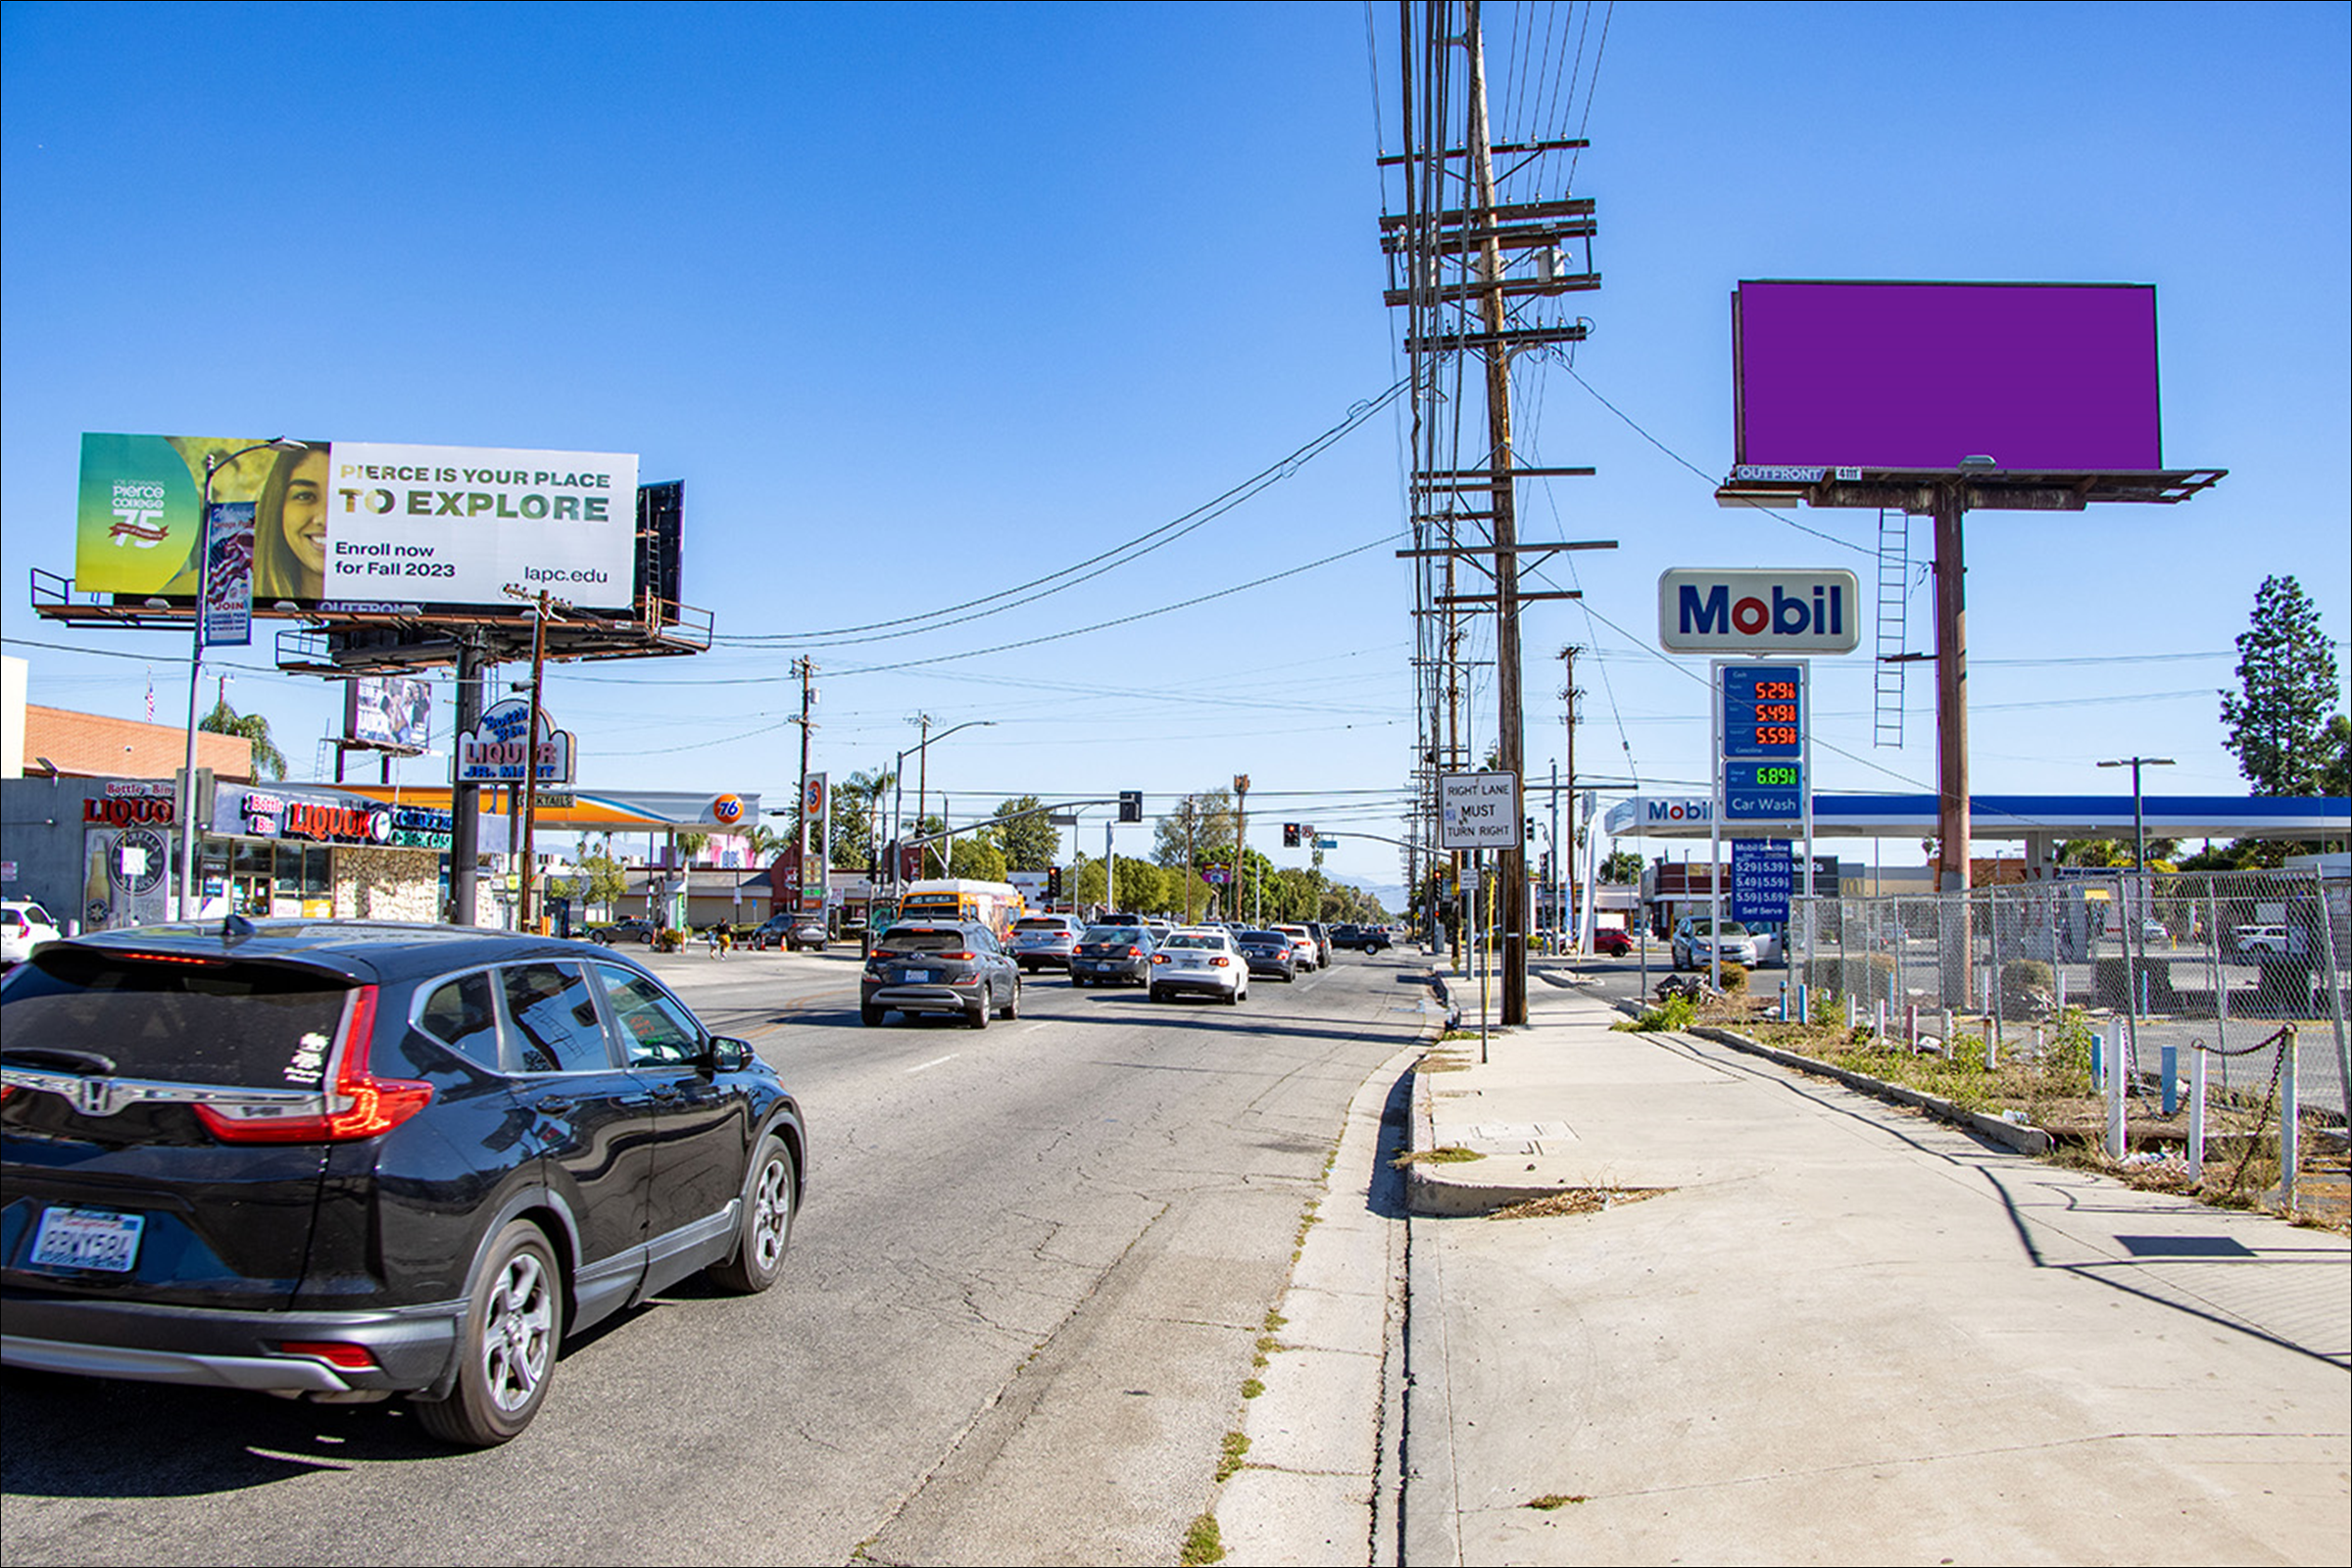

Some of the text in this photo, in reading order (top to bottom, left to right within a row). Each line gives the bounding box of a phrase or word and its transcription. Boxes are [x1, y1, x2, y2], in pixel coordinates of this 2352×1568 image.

[340, 465, 611, 488] PIERCE IS YOUR PLACE
[1740, 467, 1820, 480] OUTFRONT
[338, 488, 610, 522] TO EXPLORE
[112, 509, 165, 549] 75
[335, 541, 435, 558] Enroll now
[335, 560, 456, 578] for Fall 2023
[524, 565, 609, 585] lapc.edu
[215, 601, 244, 612] JOIN
[319, 601, 408, 613] OUTFRON
[1679, 585, 1842, 635] Mobil
[466, 743, 557, 765] LIQUR
[1447, 785, 1509, 796] RIGHT LANE
[82, 798, 175, 828] LIQUO
[717, 801, 739, 816] 76
[1461, 805, 1495, 817] MUST
[1648, 802, 1713, 820] Mobil
[1732, 798, 1796, 810] Car Wash
[289, 803, 370, 840] LIQUOR
[1447, 825, 1509, 837] TURN RIGHT
